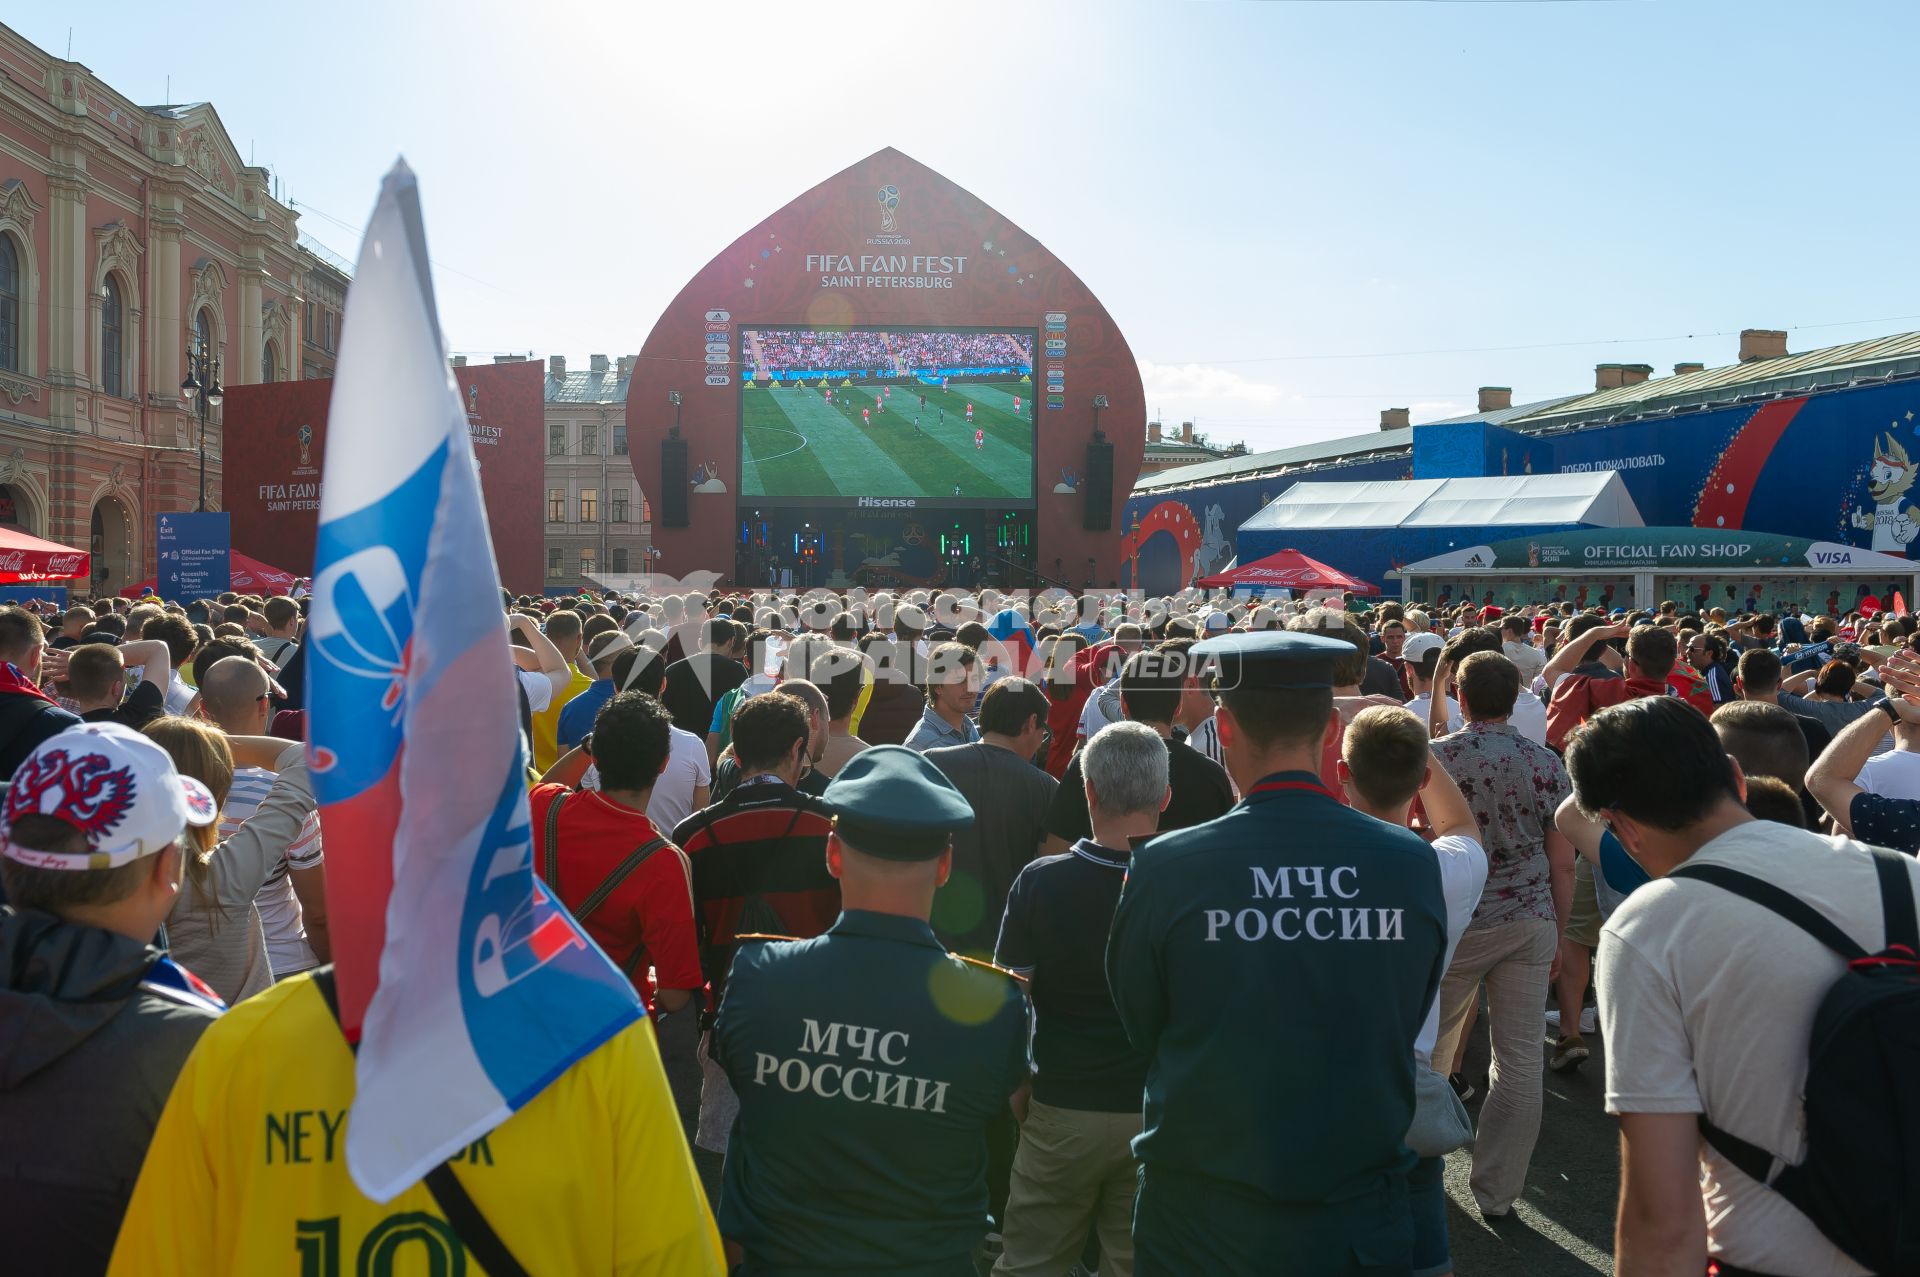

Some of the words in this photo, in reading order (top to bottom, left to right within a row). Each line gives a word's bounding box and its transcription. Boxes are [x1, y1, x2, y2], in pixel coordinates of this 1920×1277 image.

[806, 255, 855, 272] FIFA
[860, 255, 907, 273] FAN
[912, 256, 968, 274] FEST
[821, 275, 863, 288] SAINT
[866, 276, 953, 289] PETERSBURG
[481, 425, 503, 437] FEST
[1561, 462, 1592, 474] ДОБРО
[1594, 453, 1666, 472] ПОЖАЛОВАТЬ
[259, 484, 287, 500] FIFA
[289, 483, 316, 499] FAN
[267, 500, 291, 512] SAINT
[292, 500, 322, 511] PETERS
[858, 496, 916, 507] Hisense
[1875, 516, 1894, 526] 2018
[160, 526, 173, 534] Exit
[1583, 545, 1657, 558] OFFICIAL
[1661, 544, 1696, 557] FAN
[1700, 543, 1751, 557] SHOP
[1584, 558, 1630, 566] ОФИЦИАЛЬНЫЙ
[1815, 552, 1852, 564] VISA
[1249, 866, 1360, 899] МЧС
[1203, 907, 1406, 942] РОССИИ
[797, 1018, 910, 1066] МЧС
[753, 1052, 951, 1114] РОССИИ
